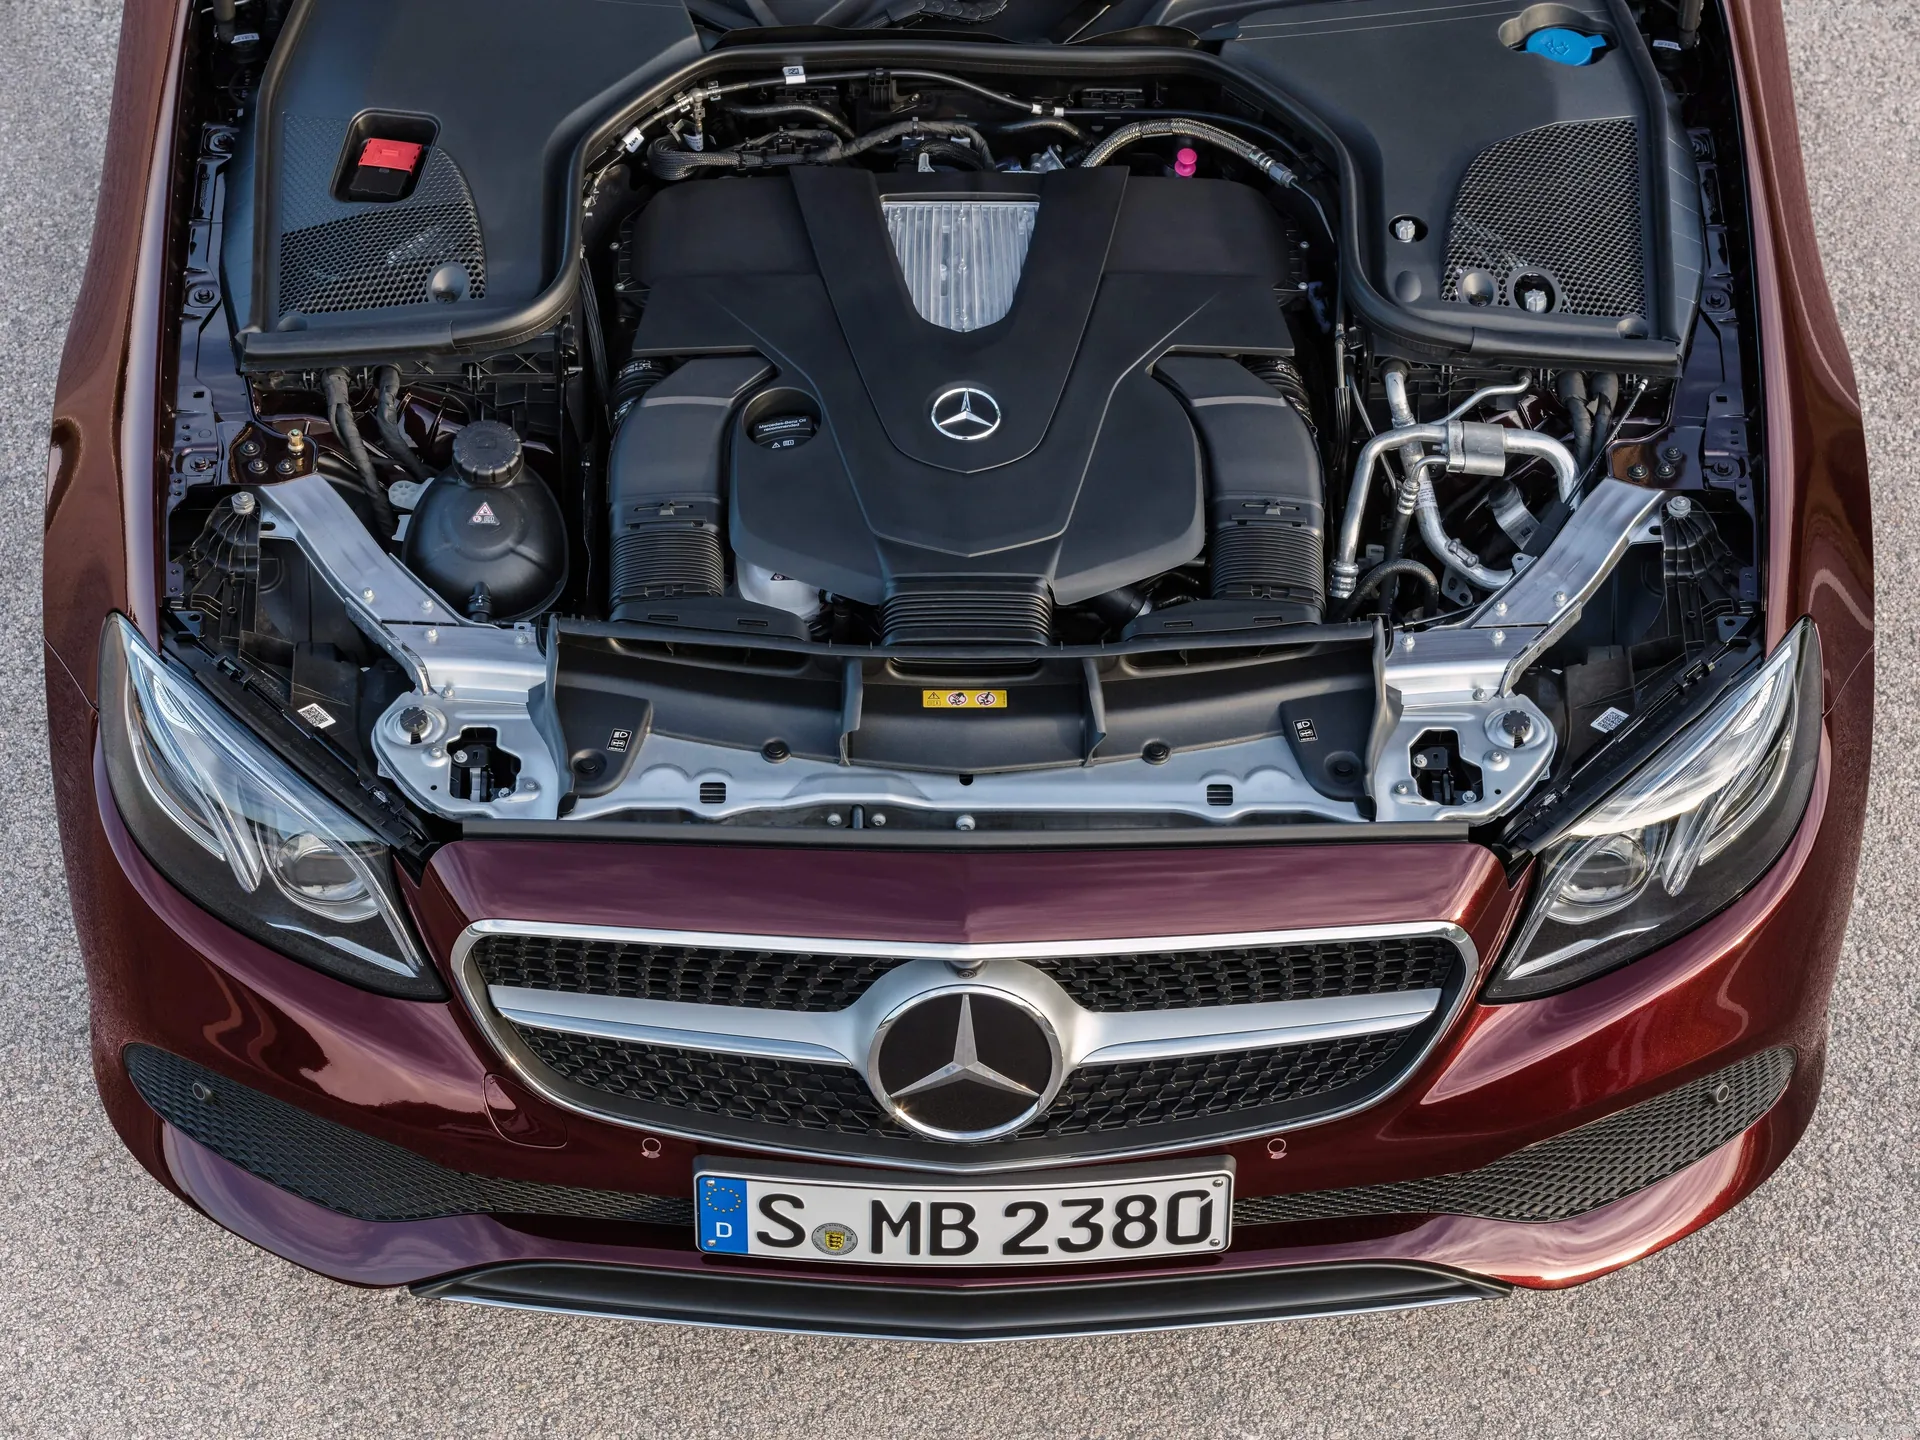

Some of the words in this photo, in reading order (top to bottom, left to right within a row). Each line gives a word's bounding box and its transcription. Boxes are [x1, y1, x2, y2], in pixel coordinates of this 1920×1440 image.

[758, 419, 798, 429] Mercedes-Benz
[763, 423, 800, 432] recommended
[715, 1221, 732, 1239] D
[756, 1193, 806, 1249] S
[870, 1199, 979, 1257] MB
[1002, 1189, 1213, 1257] 2380
